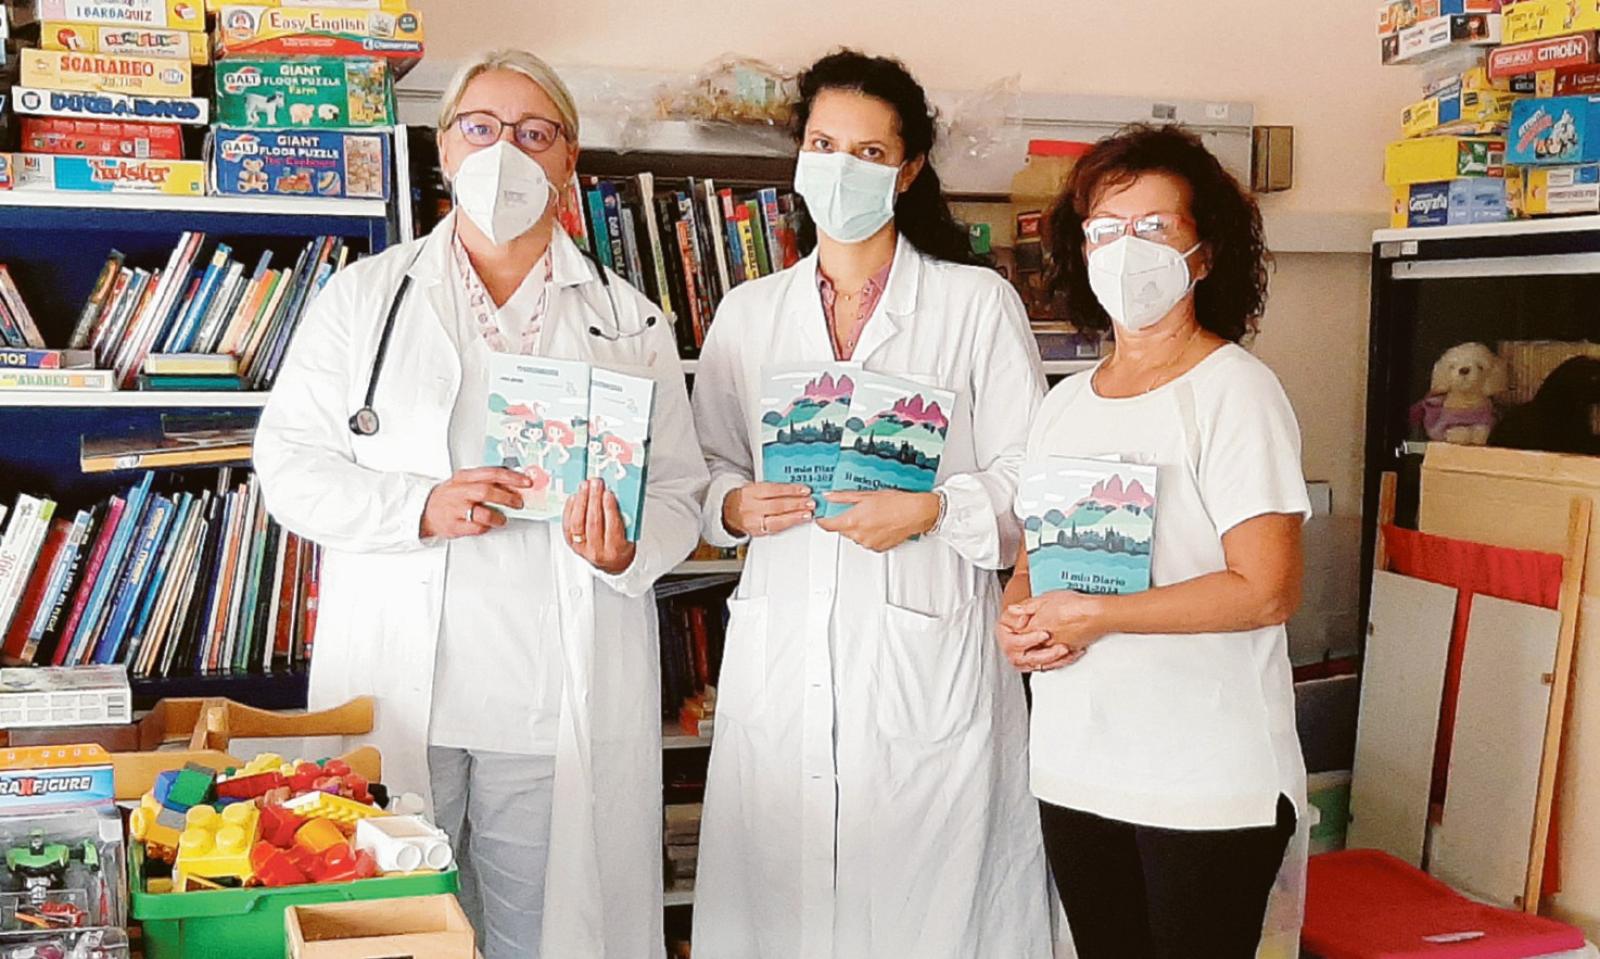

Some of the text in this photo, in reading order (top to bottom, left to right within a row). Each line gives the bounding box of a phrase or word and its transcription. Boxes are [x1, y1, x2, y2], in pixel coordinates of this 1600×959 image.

[269, 12, 365, 32] Easy English
[60, 55, 154, 77] SCARABEO
[280, 64, 322, 76] GIANT
[225, 74, 258, 85] GALT
[262, 76, 341, 87] FLOOR PUZZLE
[288, 86, 317, 95] Farm
[277, 135, 320, 147] GIANT
[223, 142, 255, 154] GALT
[260, 146, 340, 159] FLOOR PUZZLE
[88, 158, 171, 183] Twister
[1092, 574, 1126, 587] Diario
